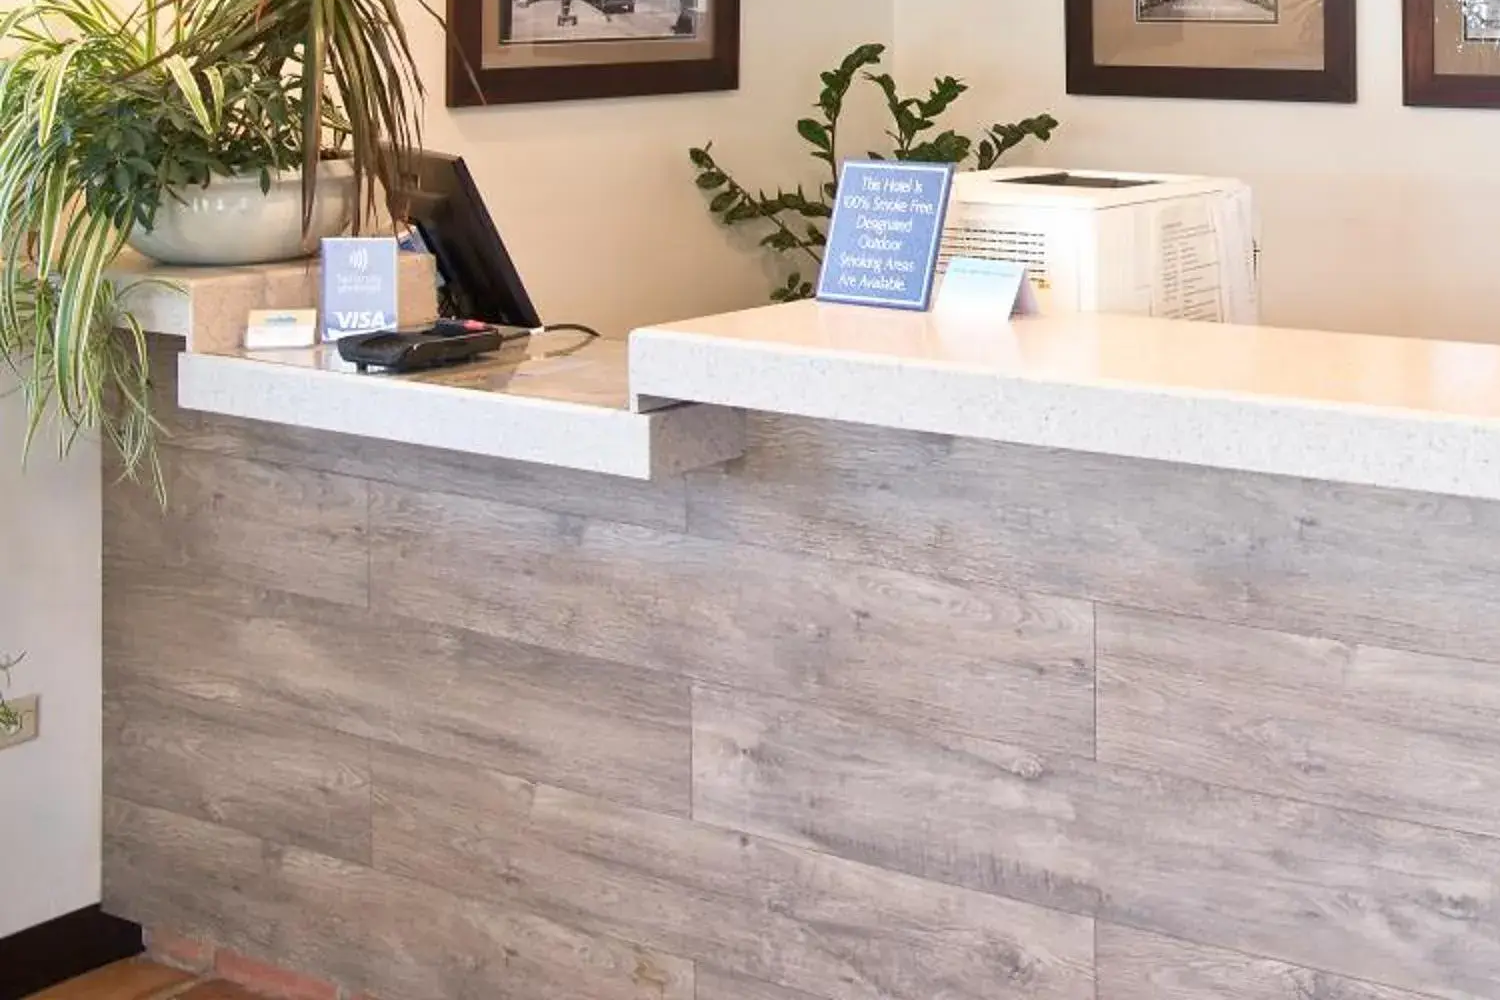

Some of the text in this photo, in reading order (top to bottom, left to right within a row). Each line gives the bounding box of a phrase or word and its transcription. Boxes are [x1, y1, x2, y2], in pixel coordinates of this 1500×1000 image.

[883, 176, 914, 194] Hotel
[843, 195, 870, 211] 100%
[872, 195, 908, 213] Smoke
[856, 214, 913, 235] Designated
[858, 233, 903, 251] Outdoor
[840, 251, 914, 273] Smoking Areas
[838, 274, 857, 288] Are
[332, 311, 386, 329] VISA
